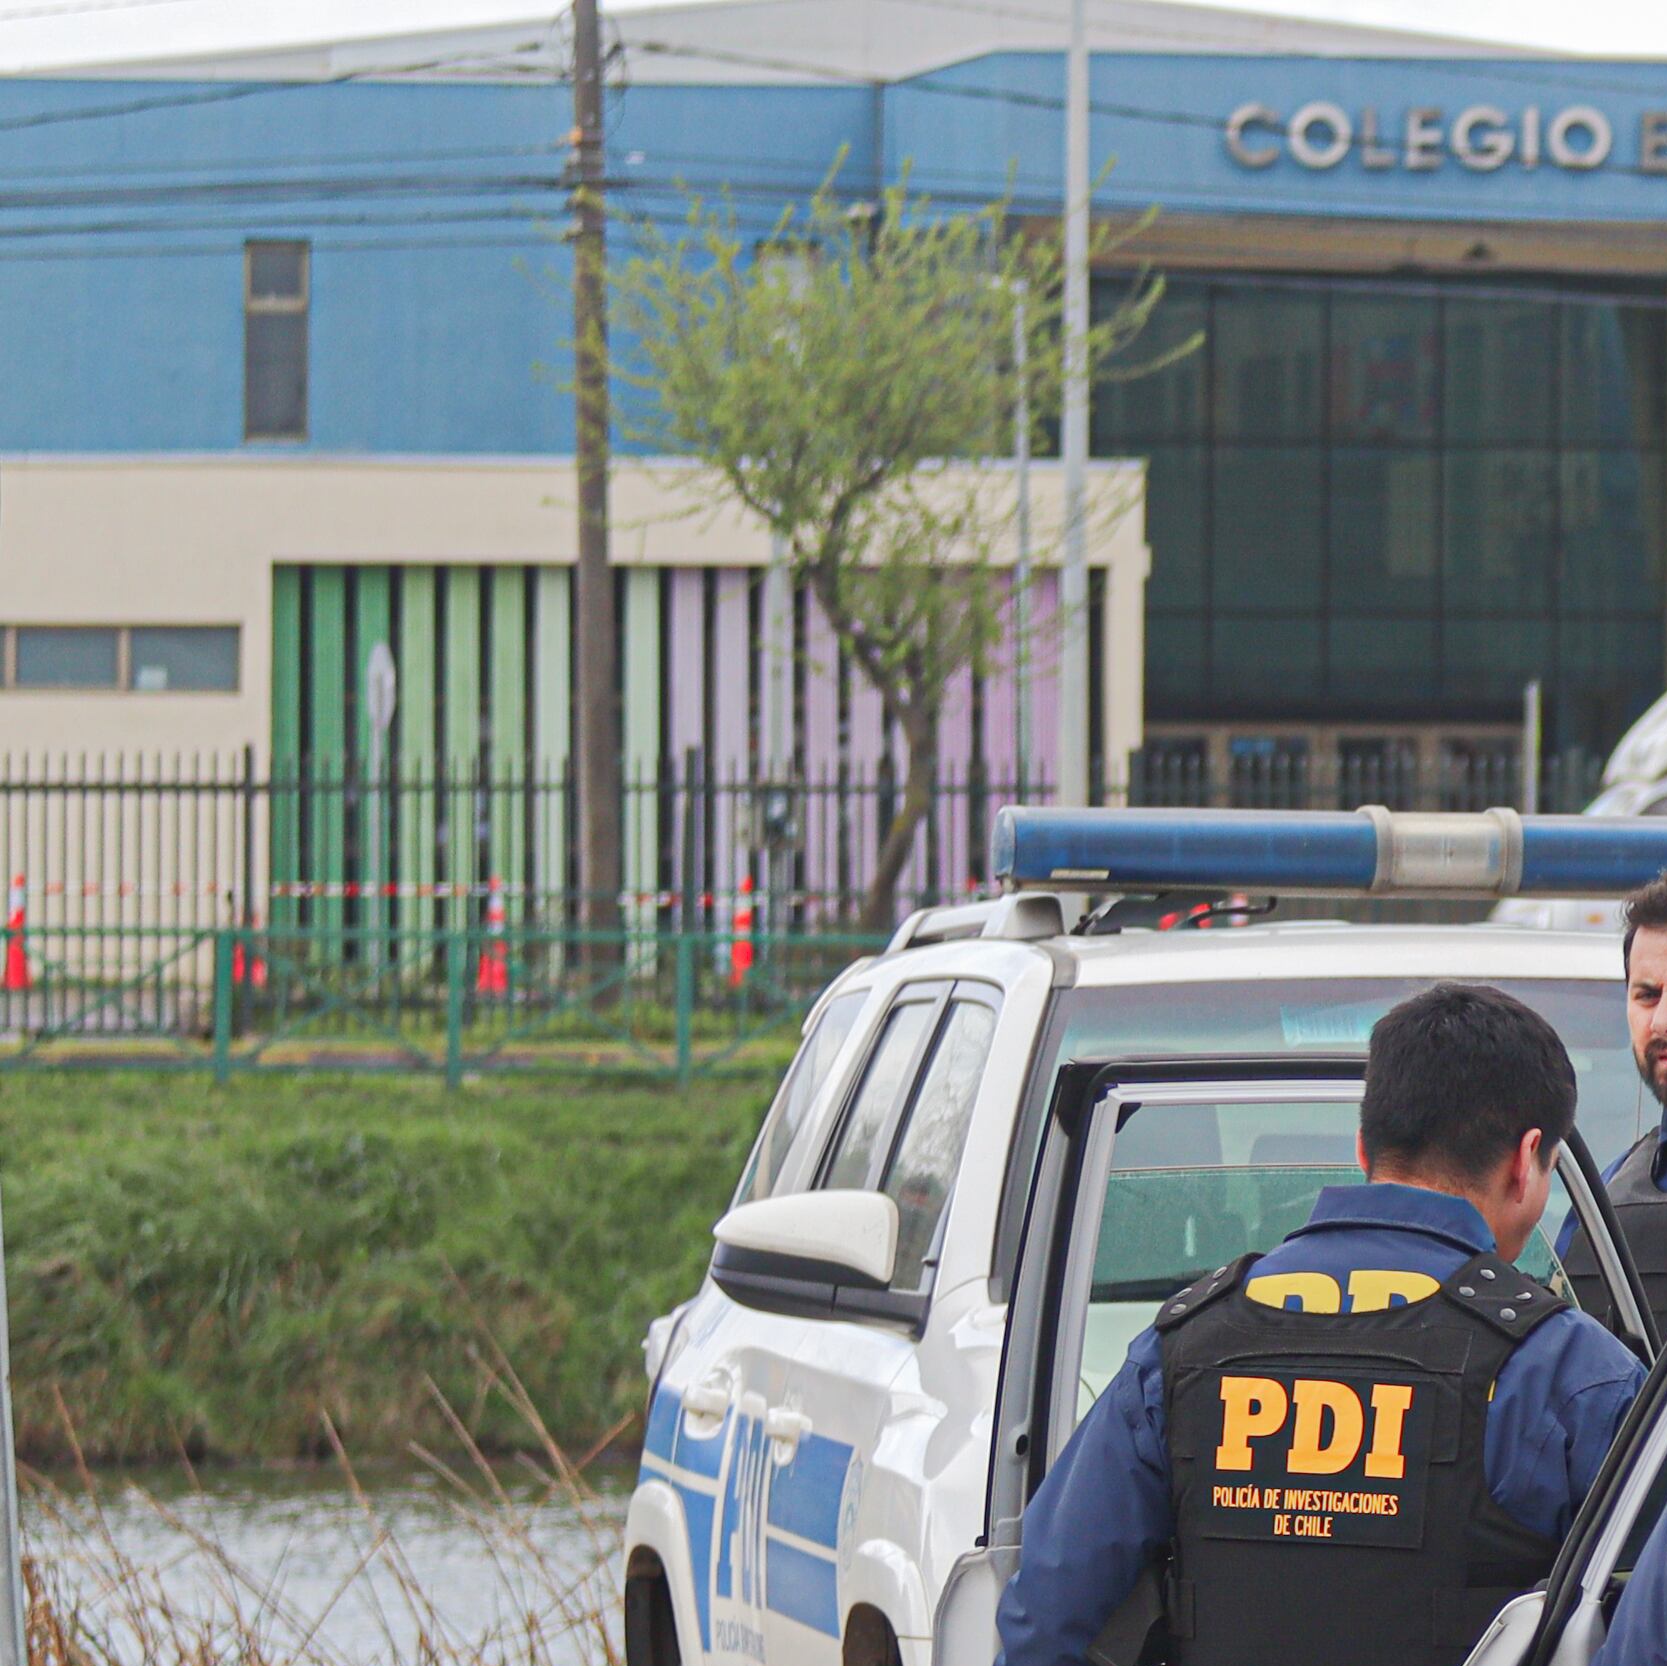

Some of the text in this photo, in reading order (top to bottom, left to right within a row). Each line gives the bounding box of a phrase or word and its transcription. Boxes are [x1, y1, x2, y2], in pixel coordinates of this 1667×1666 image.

[1225, 101, 1612, 172] COLEGIO
[1215, 1376, 1413, 1479] PDI
[1213, 1484, 1399, 1517] POLICÍA DE INVESTIGACIONES
[1273, 1514, 1333, 1538] DE CHILE
